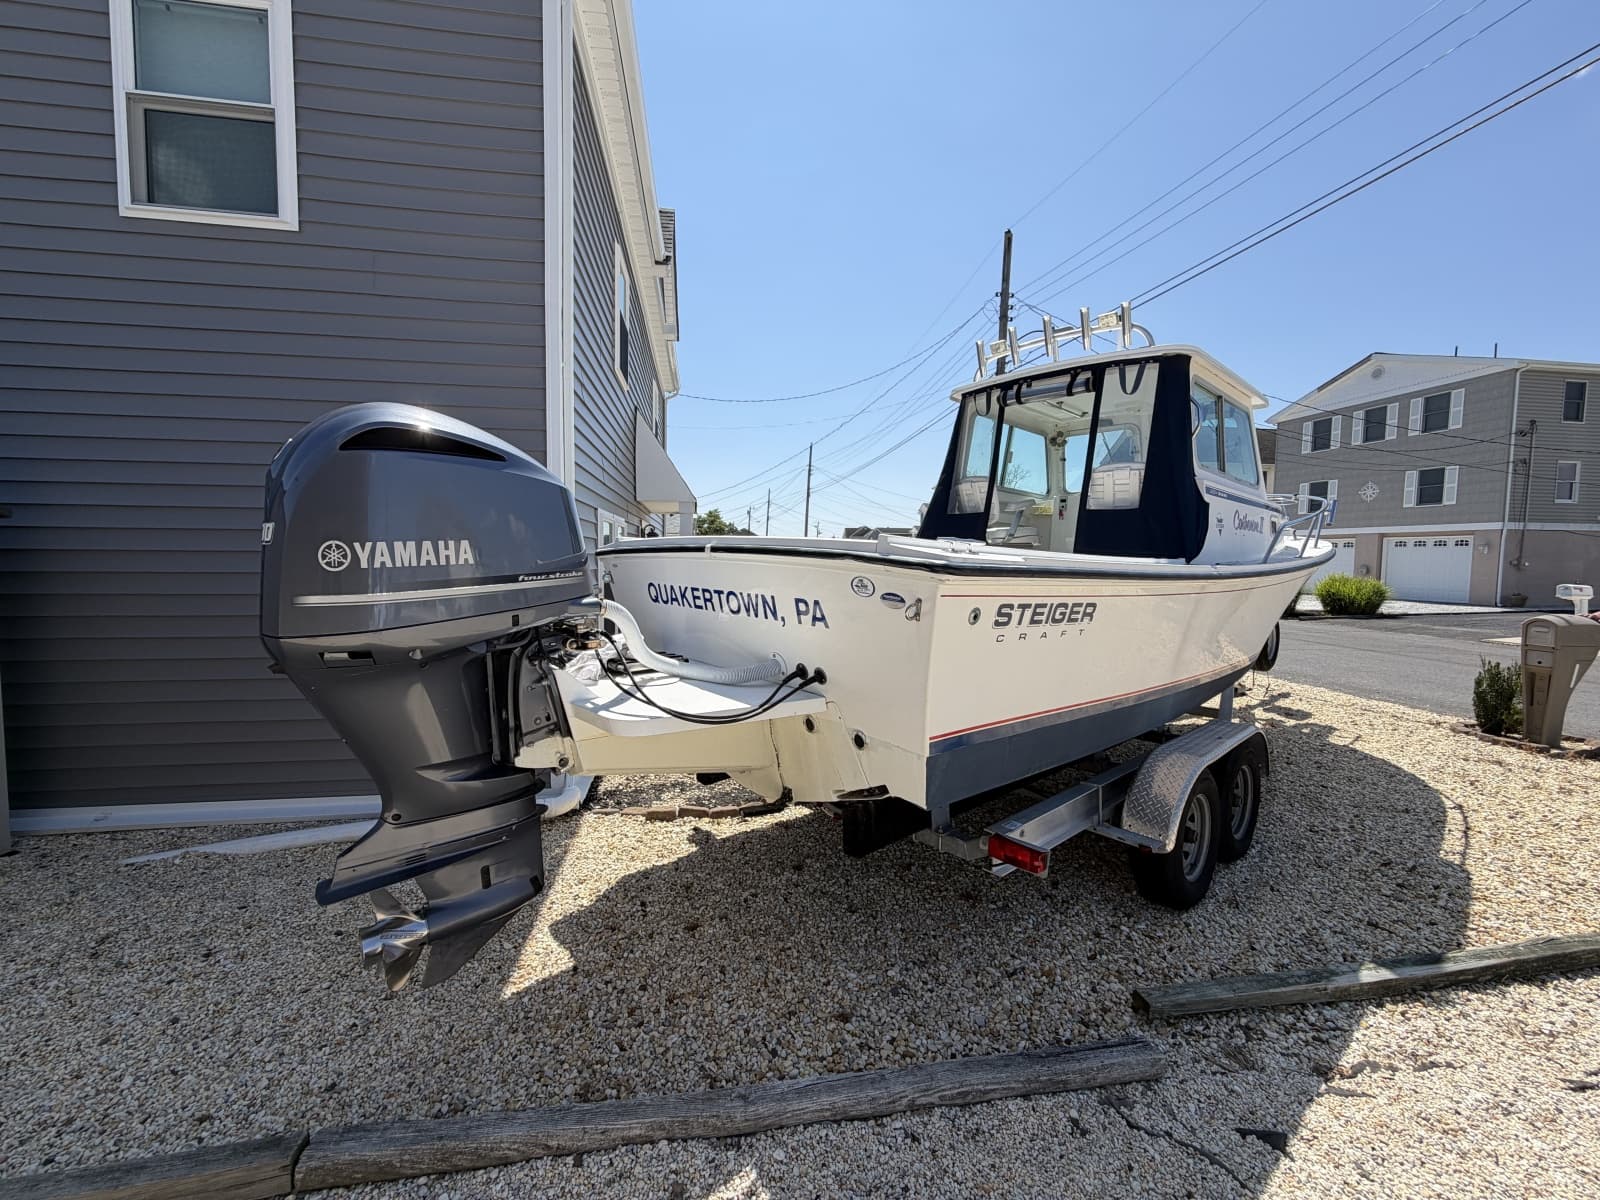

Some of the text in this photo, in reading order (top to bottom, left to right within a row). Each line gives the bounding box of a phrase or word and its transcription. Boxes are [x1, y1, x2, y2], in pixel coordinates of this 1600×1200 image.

[353, 539, 475, 569] YAMAHA
[647, 582, 830, 629] QUAKERTOWN, PA
[993, 602, 1098, 628] STEIGER
[995, 628, 1086, 643] CRAFT
